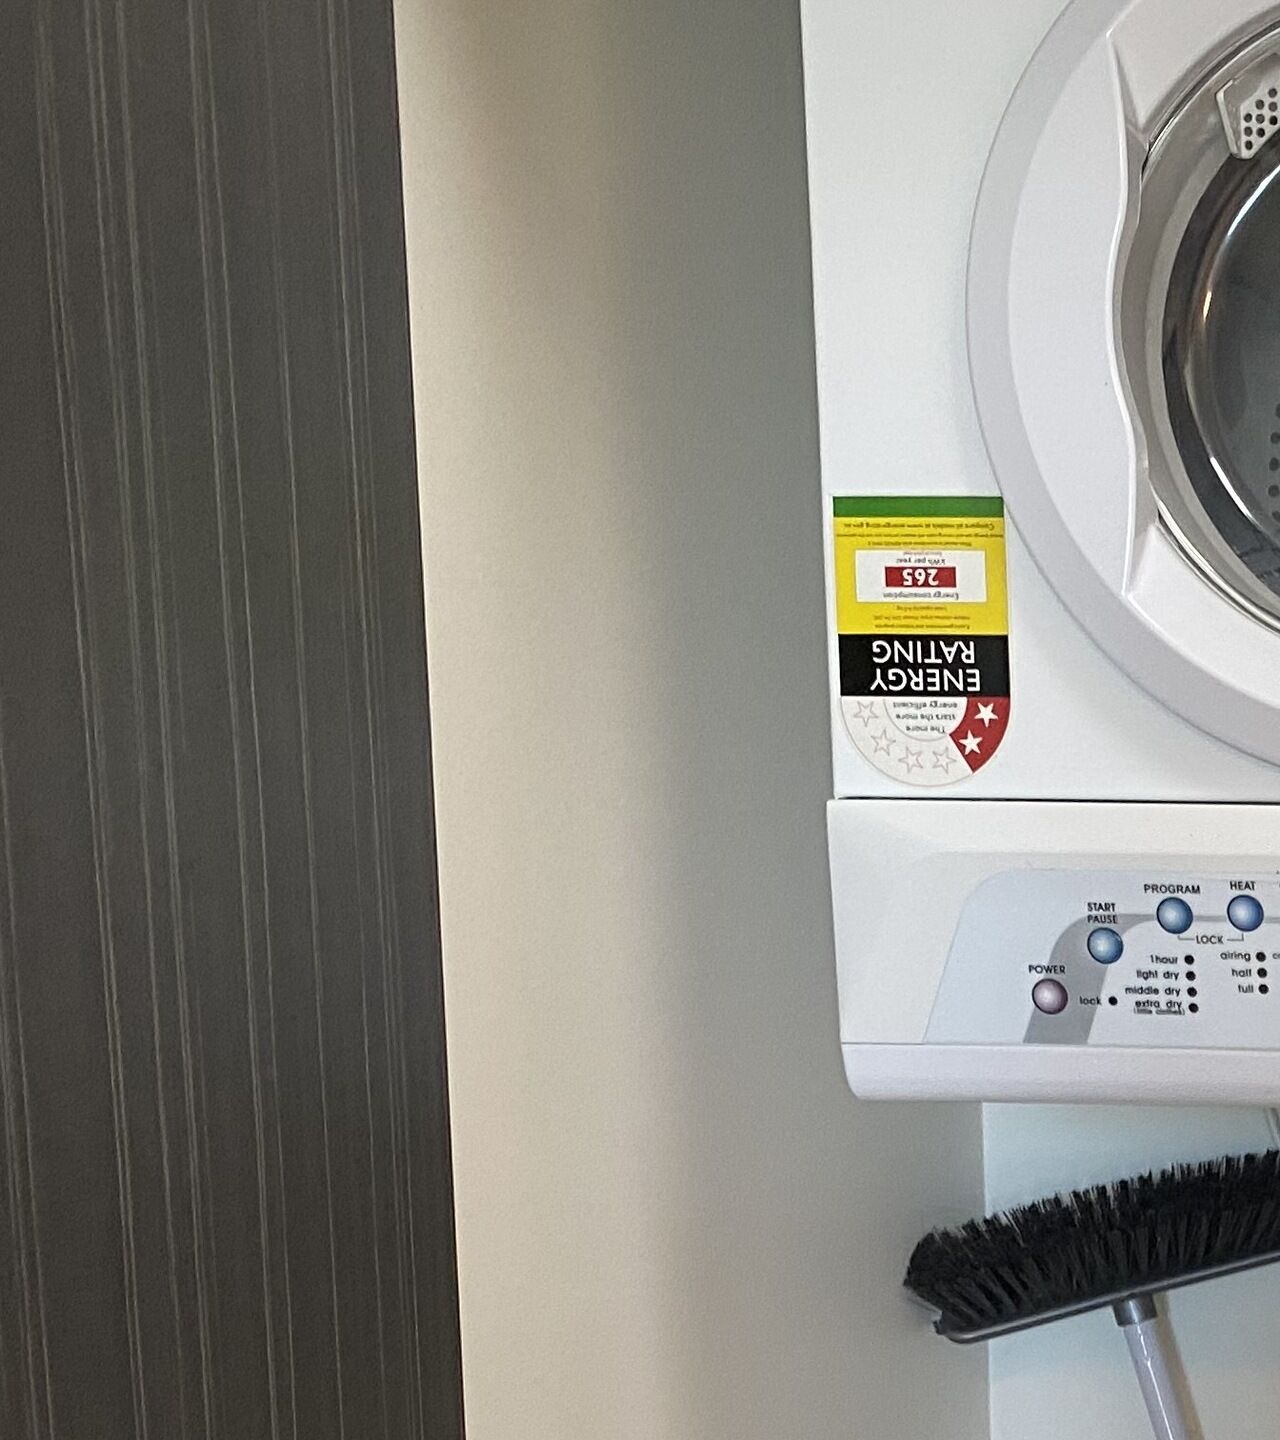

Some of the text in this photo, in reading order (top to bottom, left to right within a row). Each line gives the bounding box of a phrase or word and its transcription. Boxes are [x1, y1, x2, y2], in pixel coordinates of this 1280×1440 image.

[902, 568, 939, 585] 265
[933, 592, 959, 600] Energy
[872, 640, 975, 664] RATING
[870, 668, 980, 691] ENERGY
[893, 700, 958, 710] energy efficient
[1143, 883, 1200, 895] PROGRAM
[1229, 881, 1256, 891] HEAT
[1087, 902, 1116, 912] START
[1087, 914, 1118, 925] PAUSE
[1196, 934, 1224, 945] LOCK
[1220, 951, 1251, 962] airing
[1028, 965, 1066, 975] POWER
[1136, 969, 1180, 981] light dry
[1232, 968, 1252, 978] half
[1125, 986, 1181, 997] middle dry
[1238, 984, 1254, 994] full
[1079, 996, 1102, 1006] lock
[1135, 1000, 1182, 1009] extra dry
